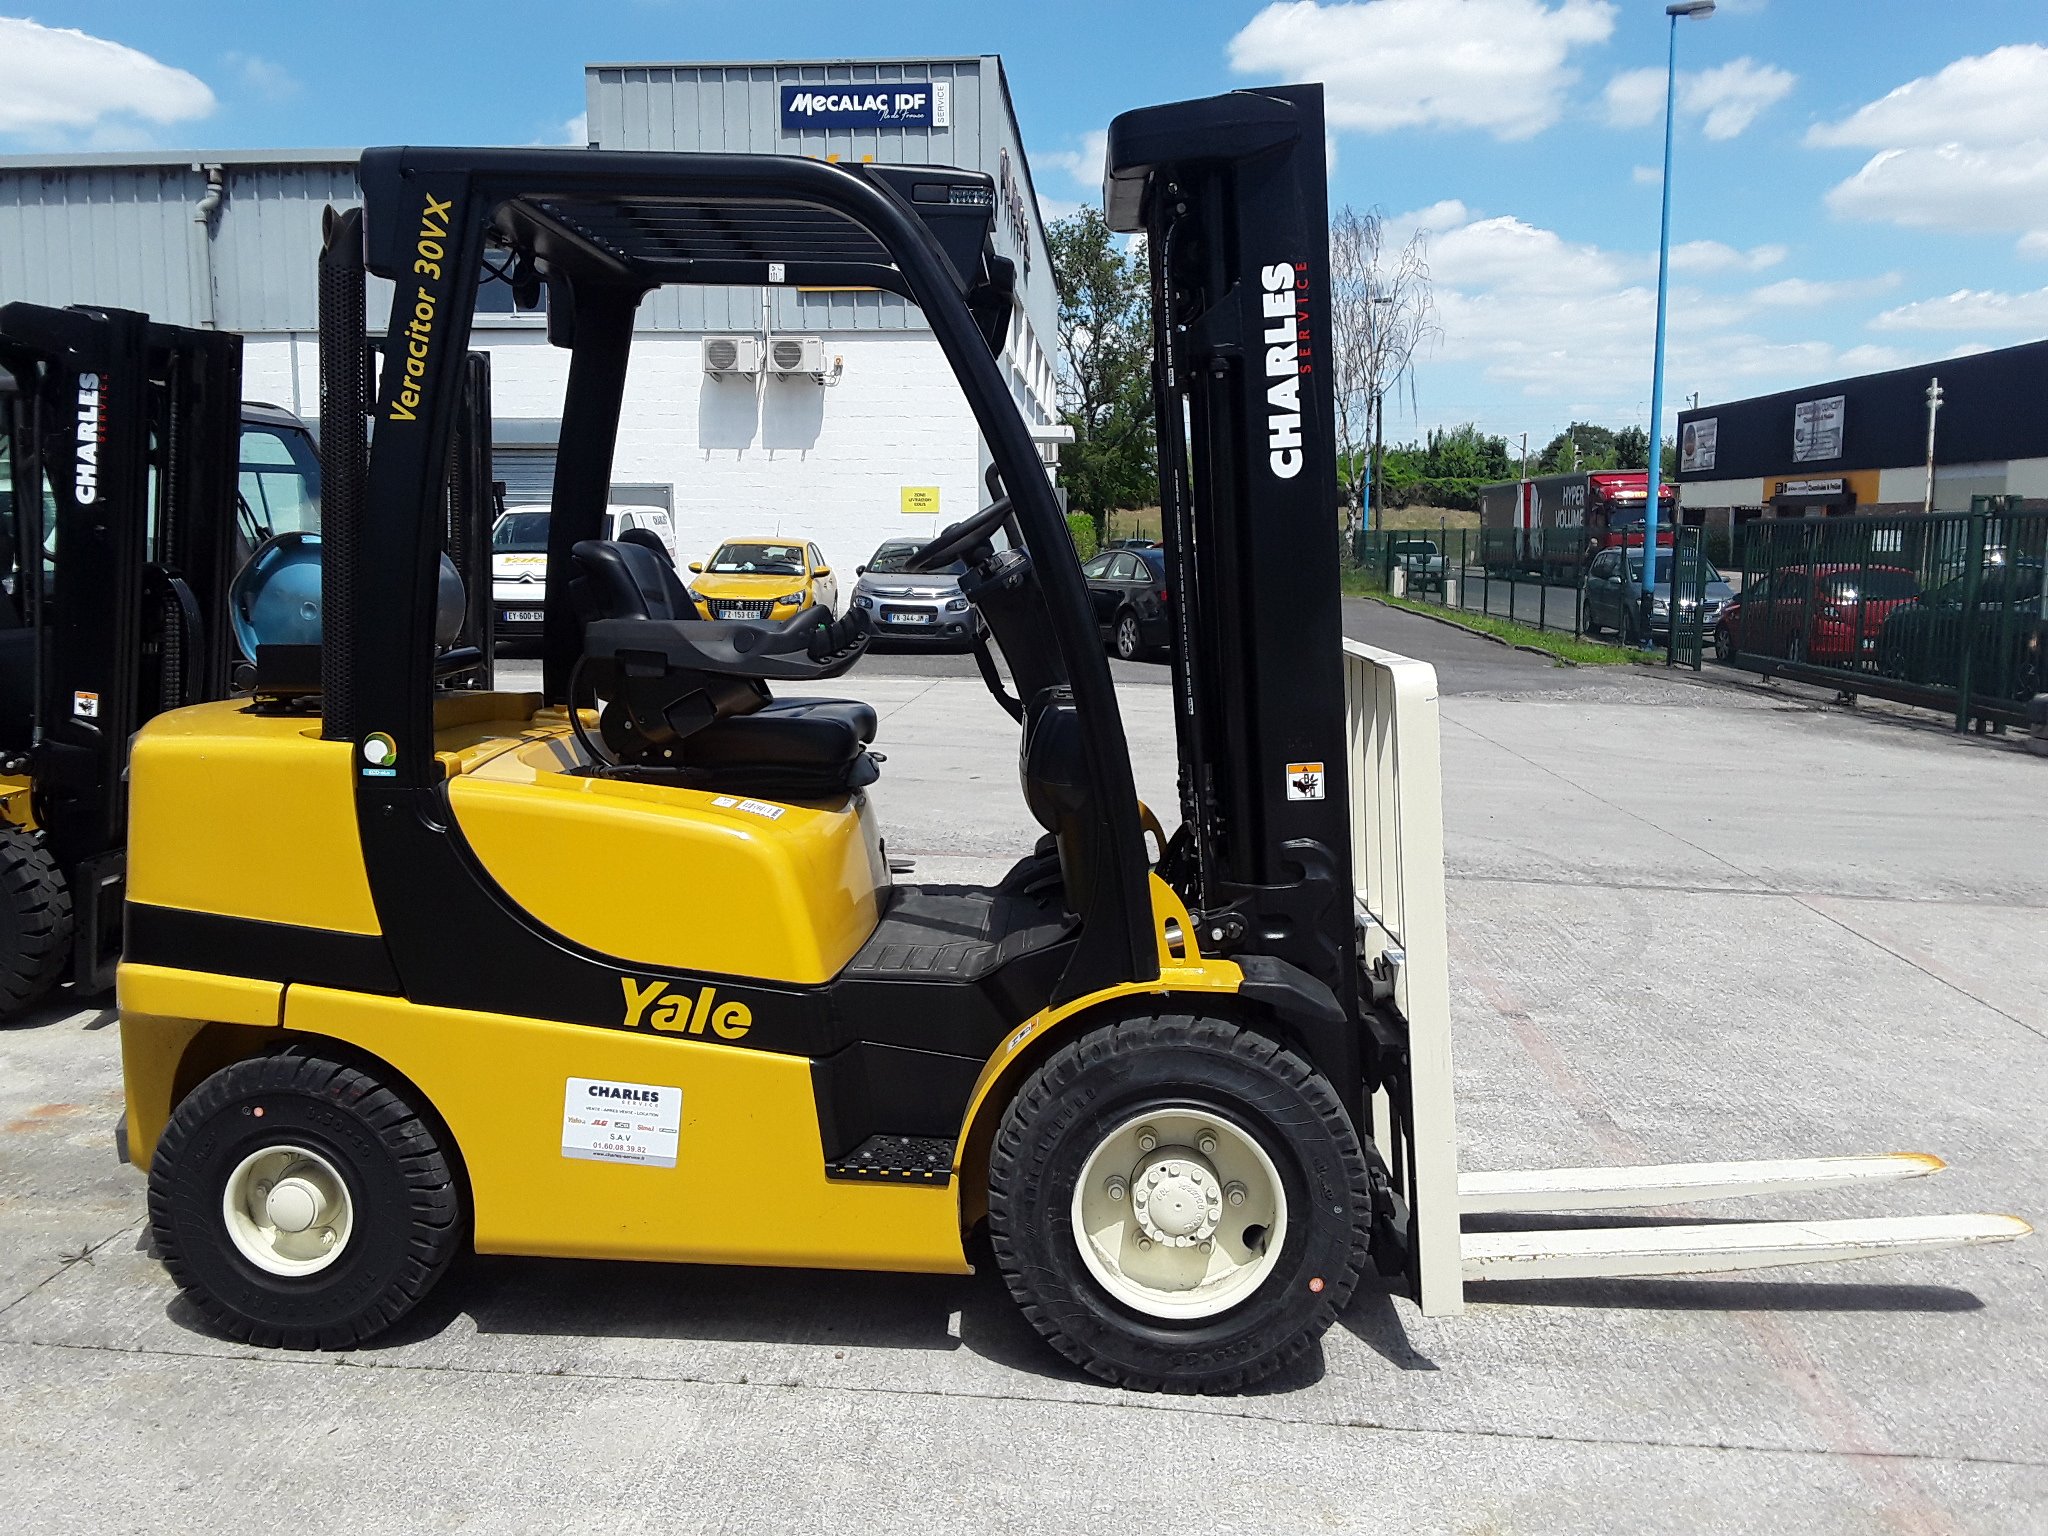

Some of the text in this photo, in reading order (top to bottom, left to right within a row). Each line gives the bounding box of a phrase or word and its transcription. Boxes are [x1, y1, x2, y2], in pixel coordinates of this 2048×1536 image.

[894, 93, 926, 110] IDF
[899, 110, 925, 122] France
[937, 85, 945, 124] SERVICE
[389, 192, 453, 421] Veracitor 30VX
[1295, 261, 1312, 374] SERVICE
[1261, 262, 1304, 479] CHARLES
[98, 374, 109, 443] SERVICE
[75, 372, 99, 505] CHARLES
[1562, 485, 1585, 507] HYPER
[1555, 508, 1585, 528] VOLUME
[621, 977, 752, 1040] Yale
[588, 1085, 660, 1103] CHARLES
[621, 1100, 659, 1108] SERVICE
[593, 1142, 647, 1154] 01.60.08.39.82
